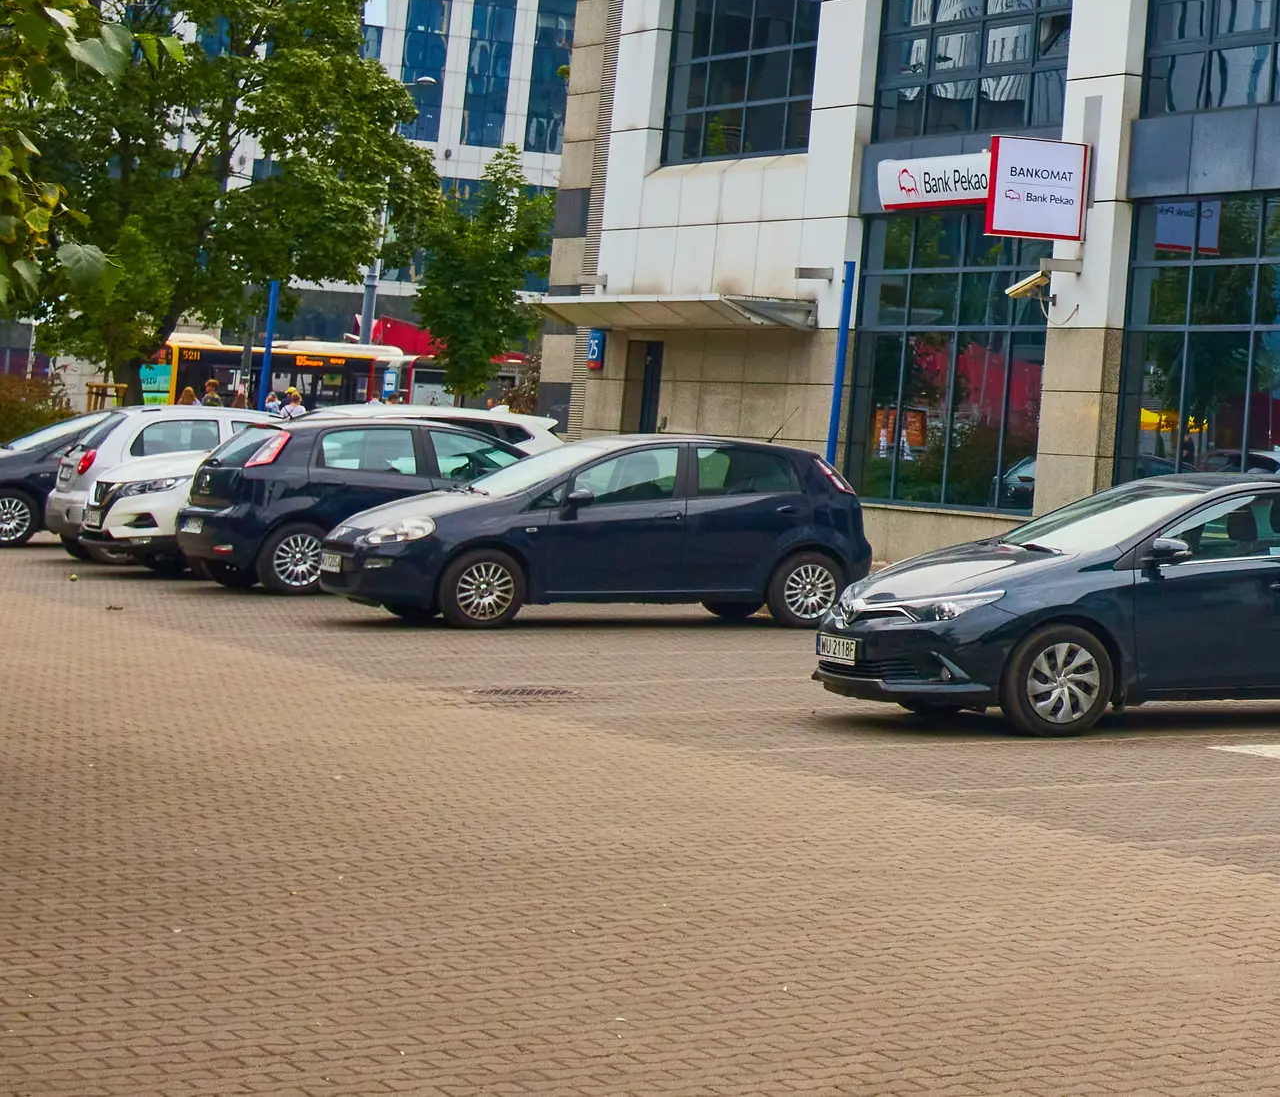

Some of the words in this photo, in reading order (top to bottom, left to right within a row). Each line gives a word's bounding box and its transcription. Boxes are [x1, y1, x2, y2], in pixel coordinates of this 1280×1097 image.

[923, 170, 952, 194] Bank
[953, 168, 988, 192] Pekao
[1009, 166, 1074, 182] BANKOMAT
[1026, 192, 1048, 203] Bank
[1049, 194, 1075, 206] Pekao
[588, 339, 599, 359] 25
[821, 637, 832, 654] WU
[833, 639, 855, 658] 2118F
